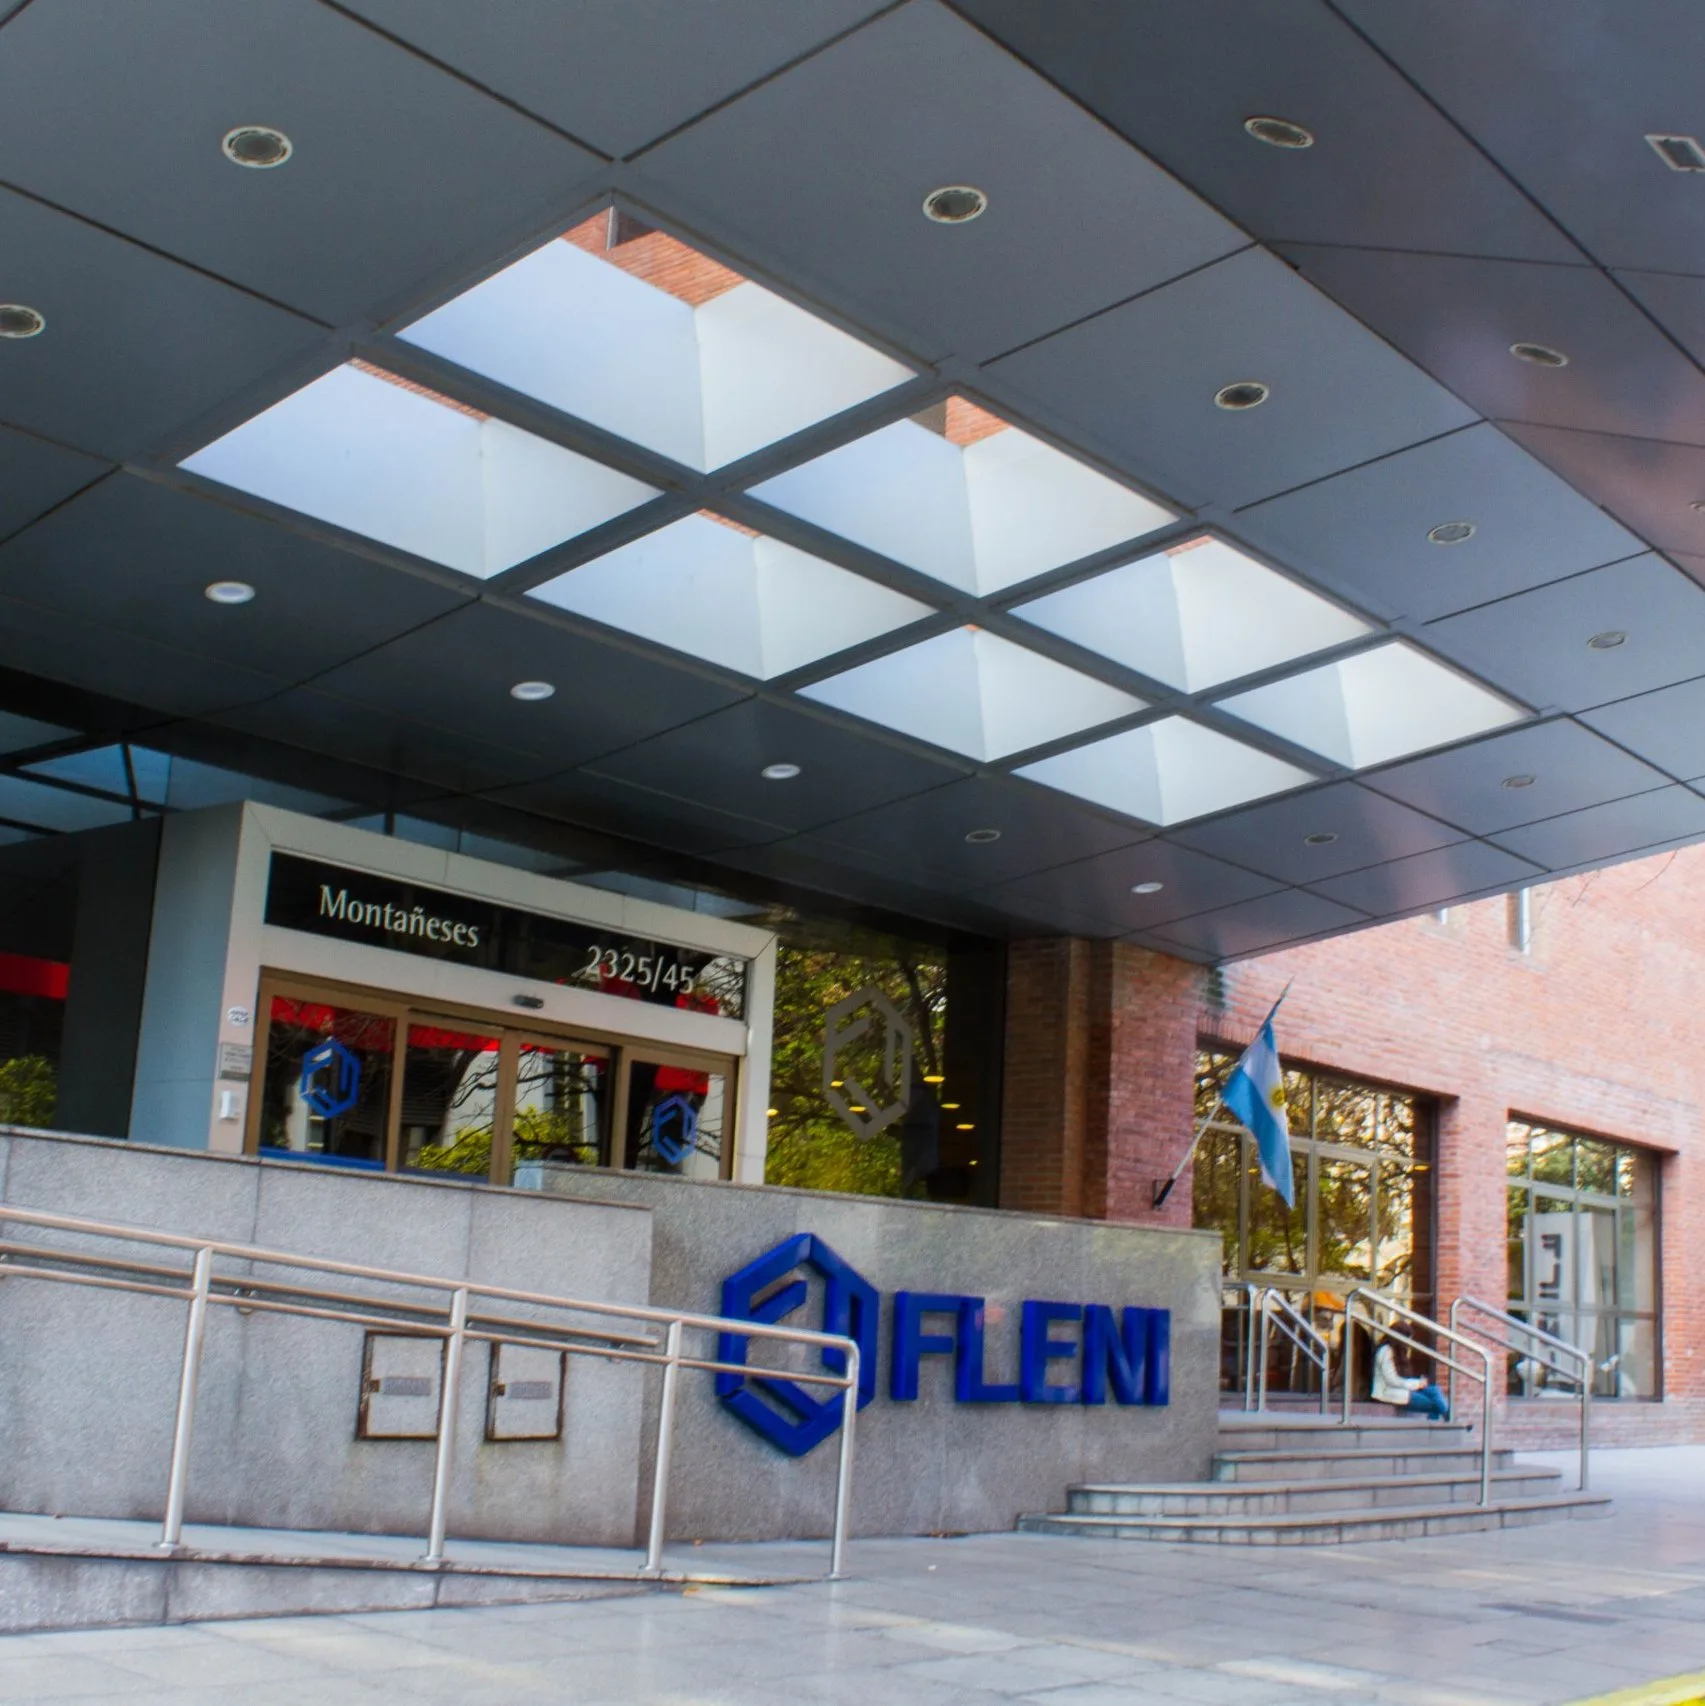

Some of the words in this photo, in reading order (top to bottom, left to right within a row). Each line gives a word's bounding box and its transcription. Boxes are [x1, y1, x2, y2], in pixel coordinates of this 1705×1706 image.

[319, 883, 480, 948] Montañeses
[586, 945, 695, 994] 2325/45
[890, 1290, 1171, 1406] FLENI
